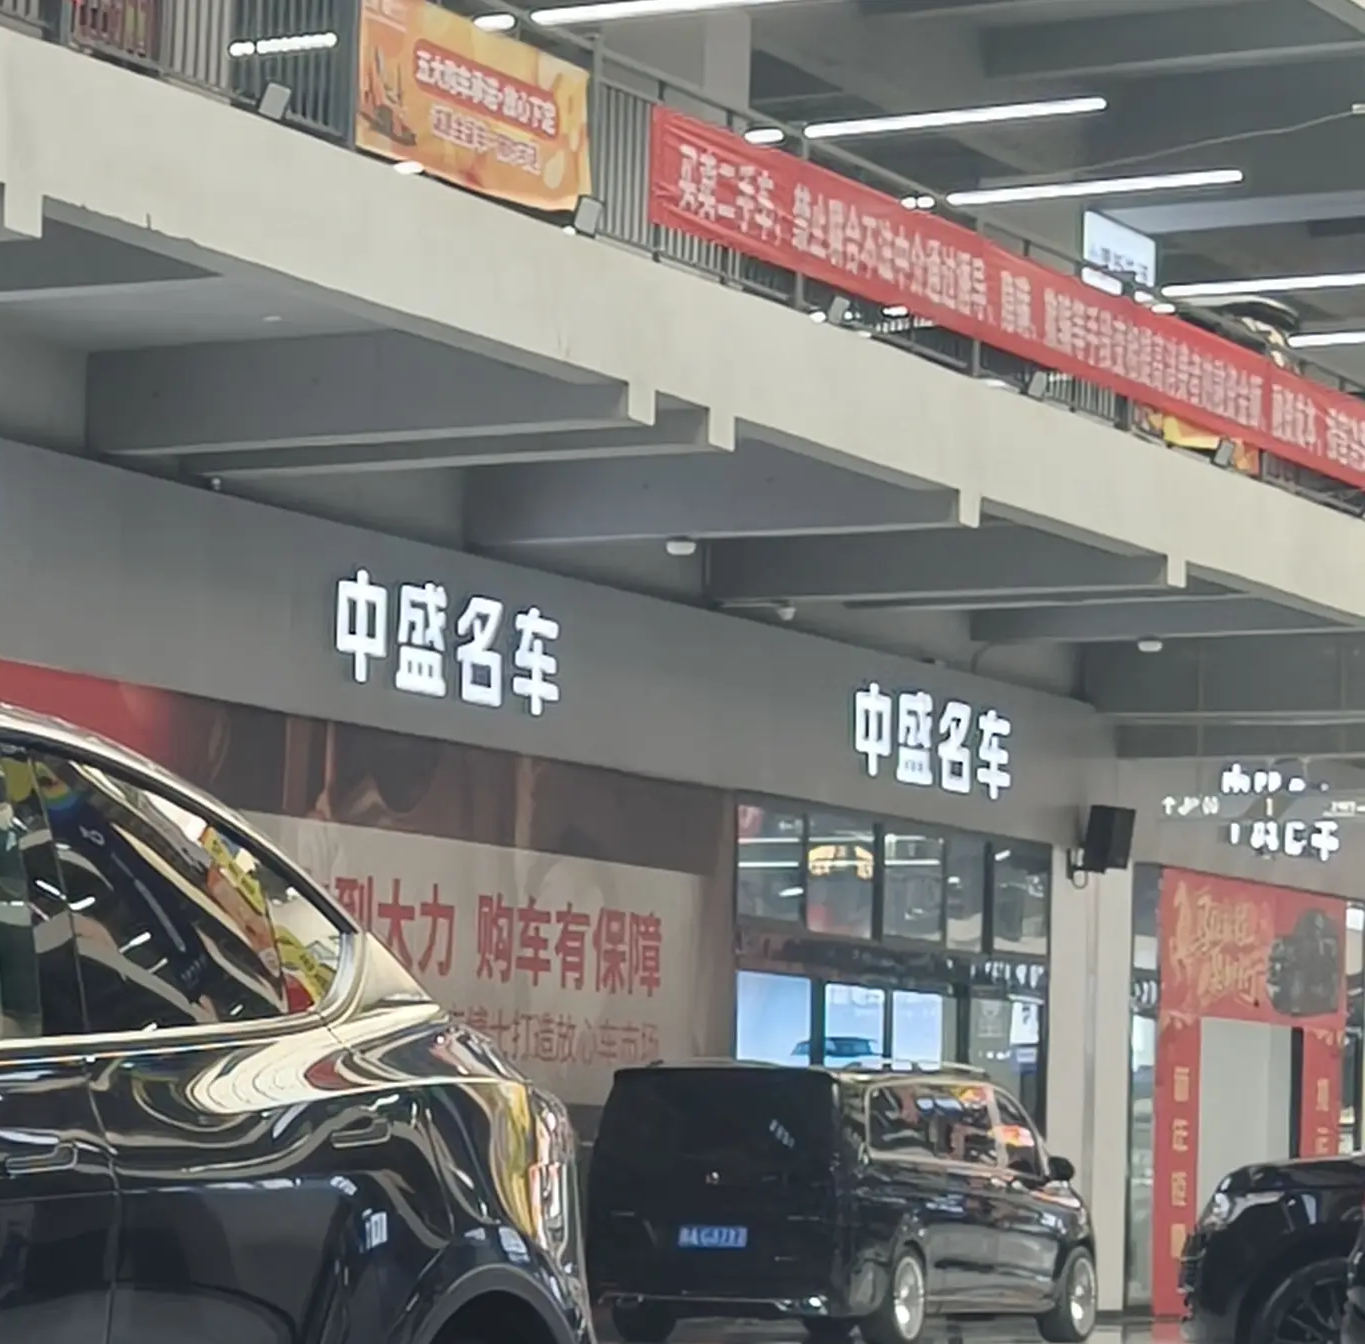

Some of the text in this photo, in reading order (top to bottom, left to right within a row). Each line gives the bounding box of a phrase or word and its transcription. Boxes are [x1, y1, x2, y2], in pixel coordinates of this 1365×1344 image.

[335, 568, 560, 717] 中盛名车
[854, 681, 1012, 799] 中盛名车
[476, 892, 663, 997] 购车有保障
